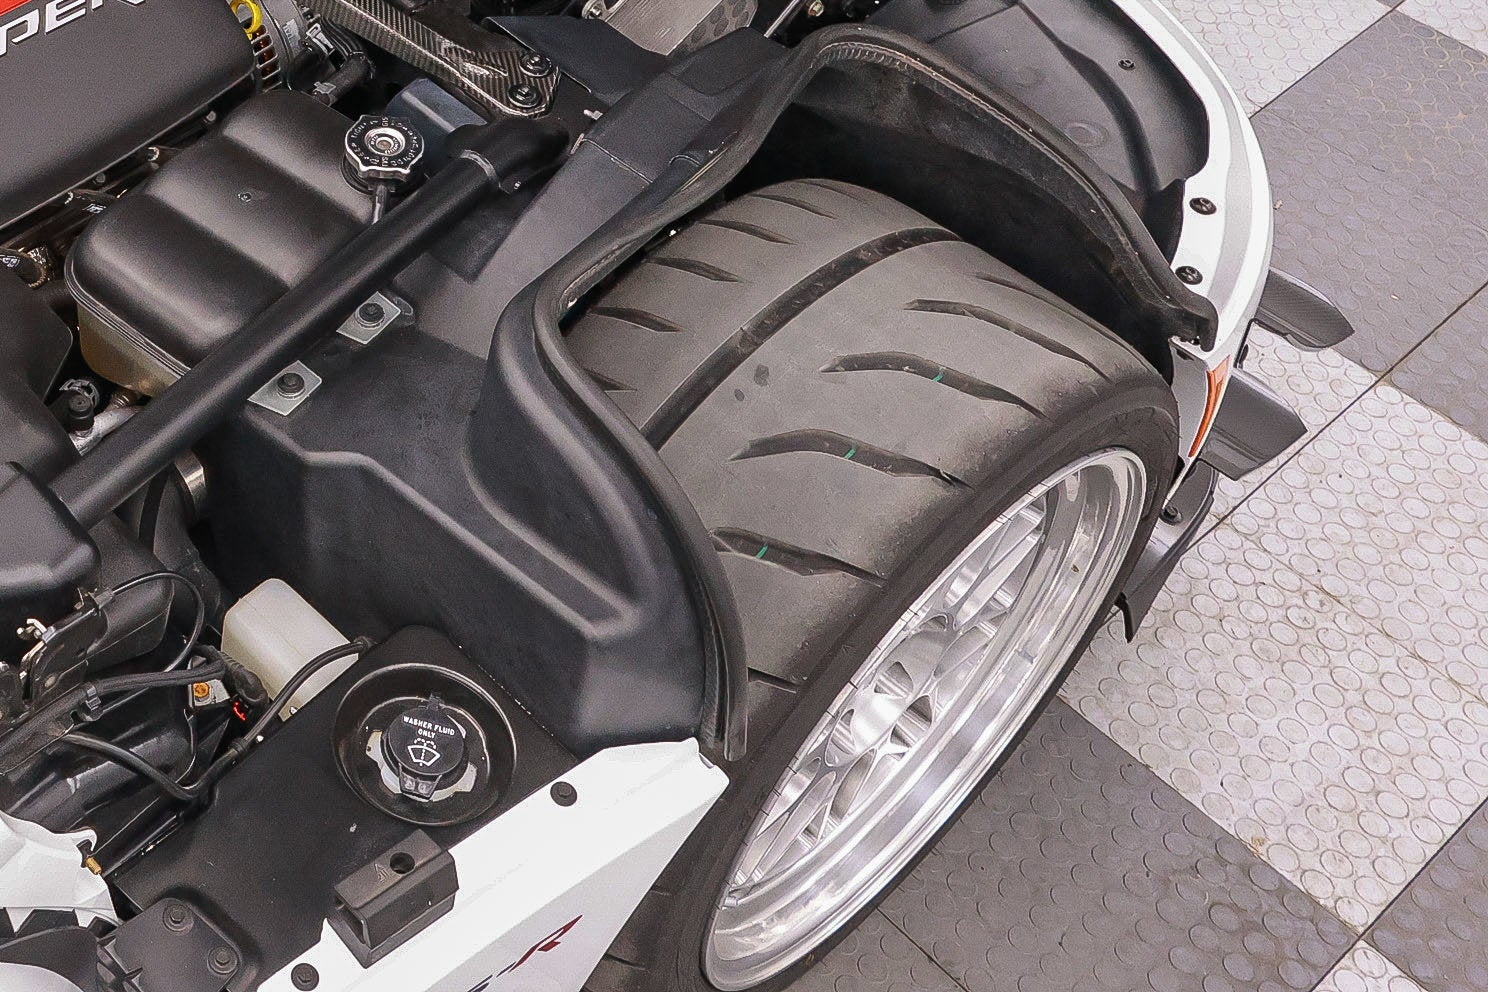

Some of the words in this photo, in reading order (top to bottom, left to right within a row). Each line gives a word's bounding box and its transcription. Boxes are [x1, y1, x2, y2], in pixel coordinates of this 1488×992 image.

[403, 715, 433, 730] WASHER
[434, 724, 455, 736] FLUID
[417, 728, 436, 739] ONLY
